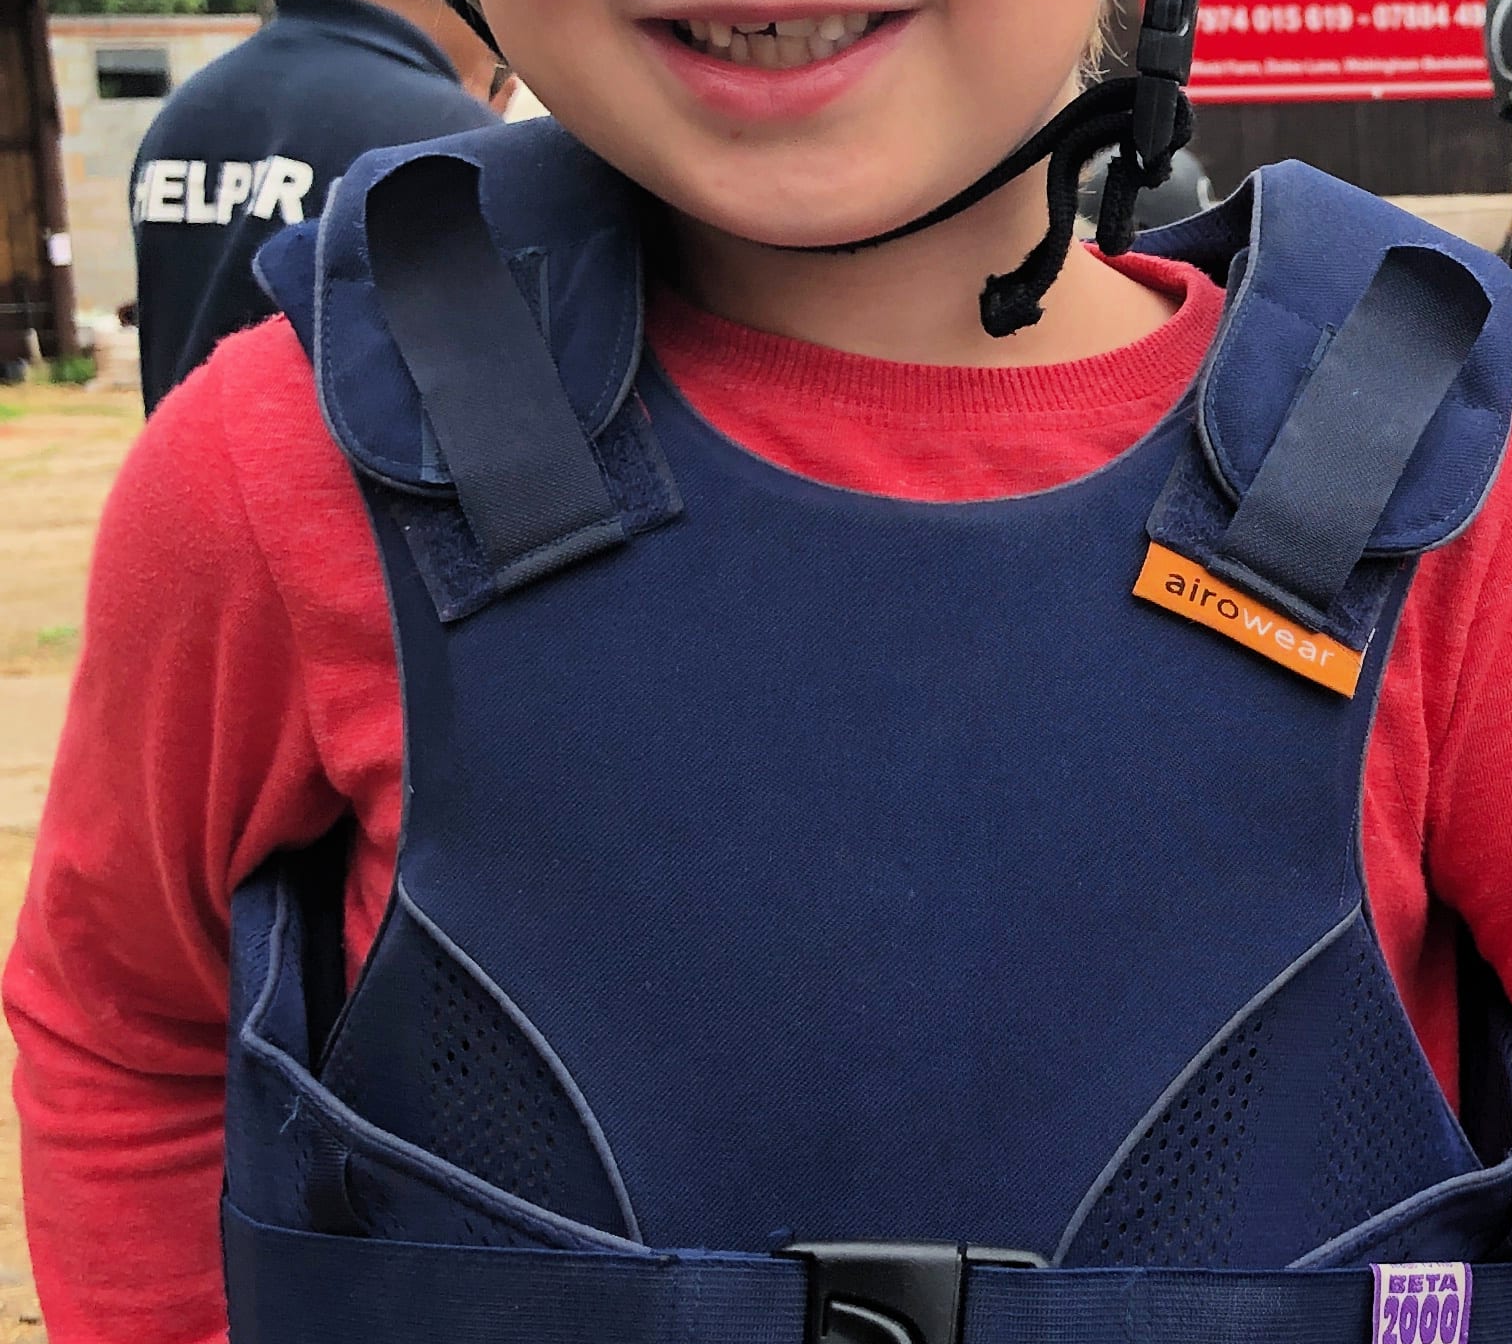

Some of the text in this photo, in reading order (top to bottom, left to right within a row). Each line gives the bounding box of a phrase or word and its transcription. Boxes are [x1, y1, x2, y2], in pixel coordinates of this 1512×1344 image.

[135, 155, 314, 226] HELPR
[1165, 573, 1335, 667] airowear
[1389, 1274, 1458, 1293] BETA
